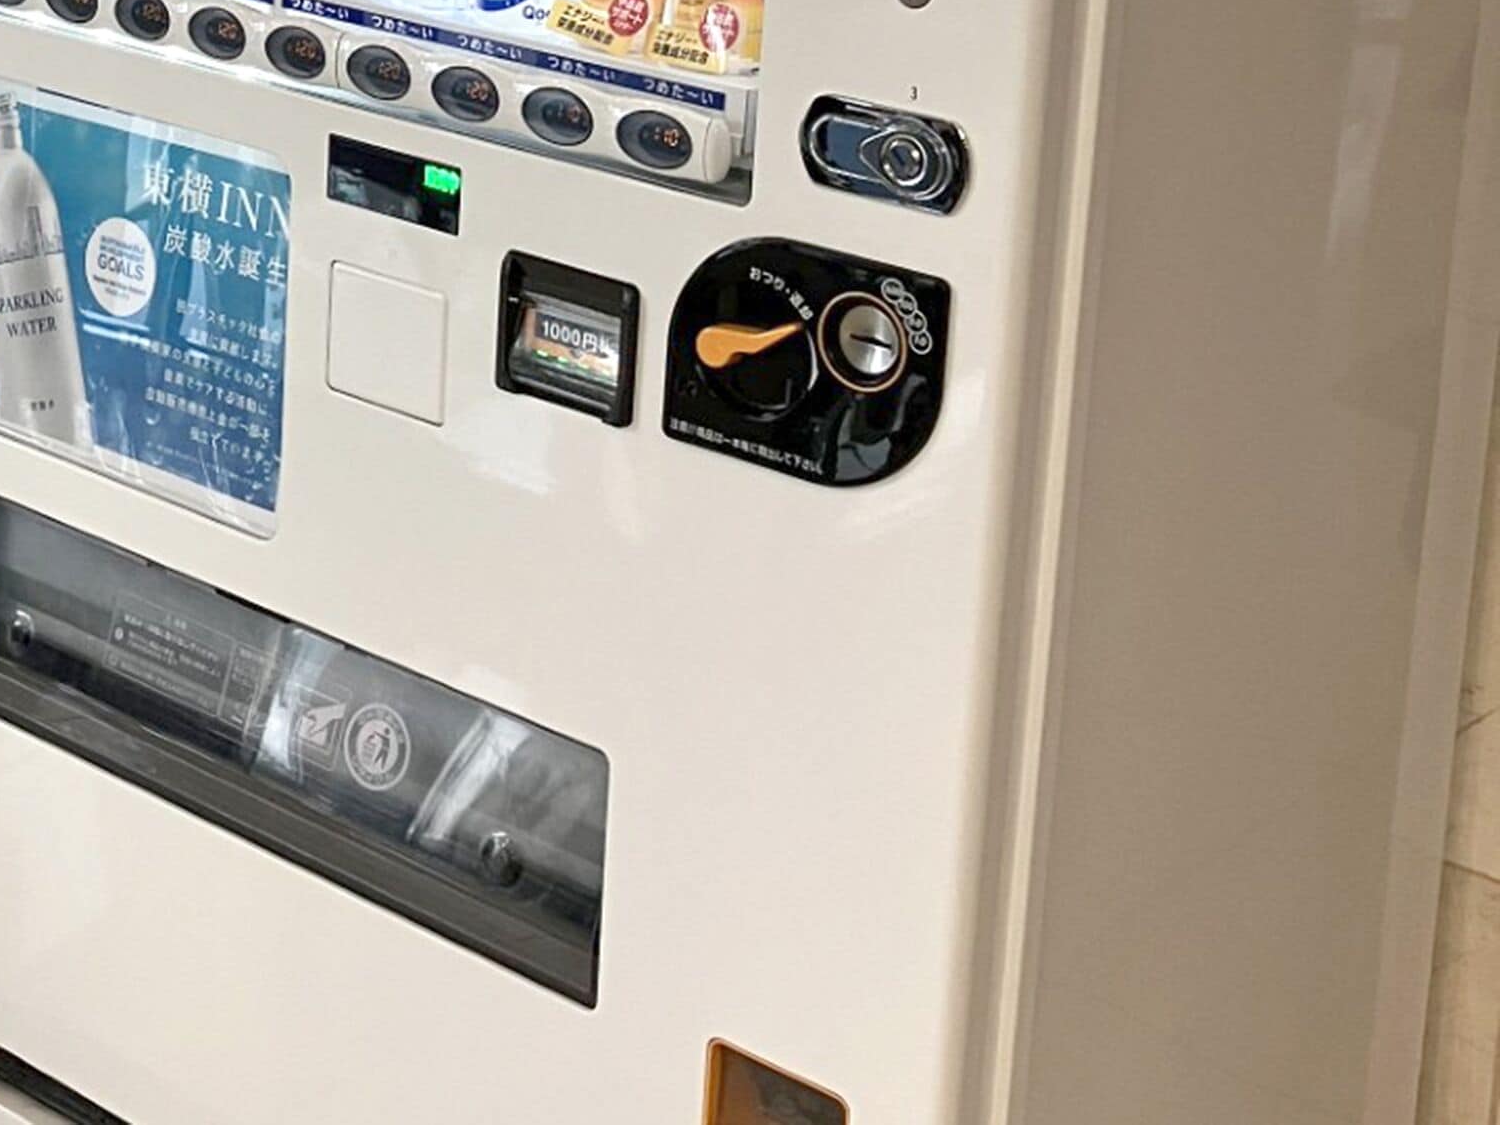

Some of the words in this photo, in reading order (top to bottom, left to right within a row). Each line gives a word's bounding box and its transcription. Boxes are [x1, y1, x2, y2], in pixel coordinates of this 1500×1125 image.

[908, 85, 919, 102] 3
[145, 159, 291, 241] 東横INN
[97, 253, 146, 281] GOALS
[163, 223, 288, 289] 炭酸水誕生
[6, 315, 58, 338] WATER
